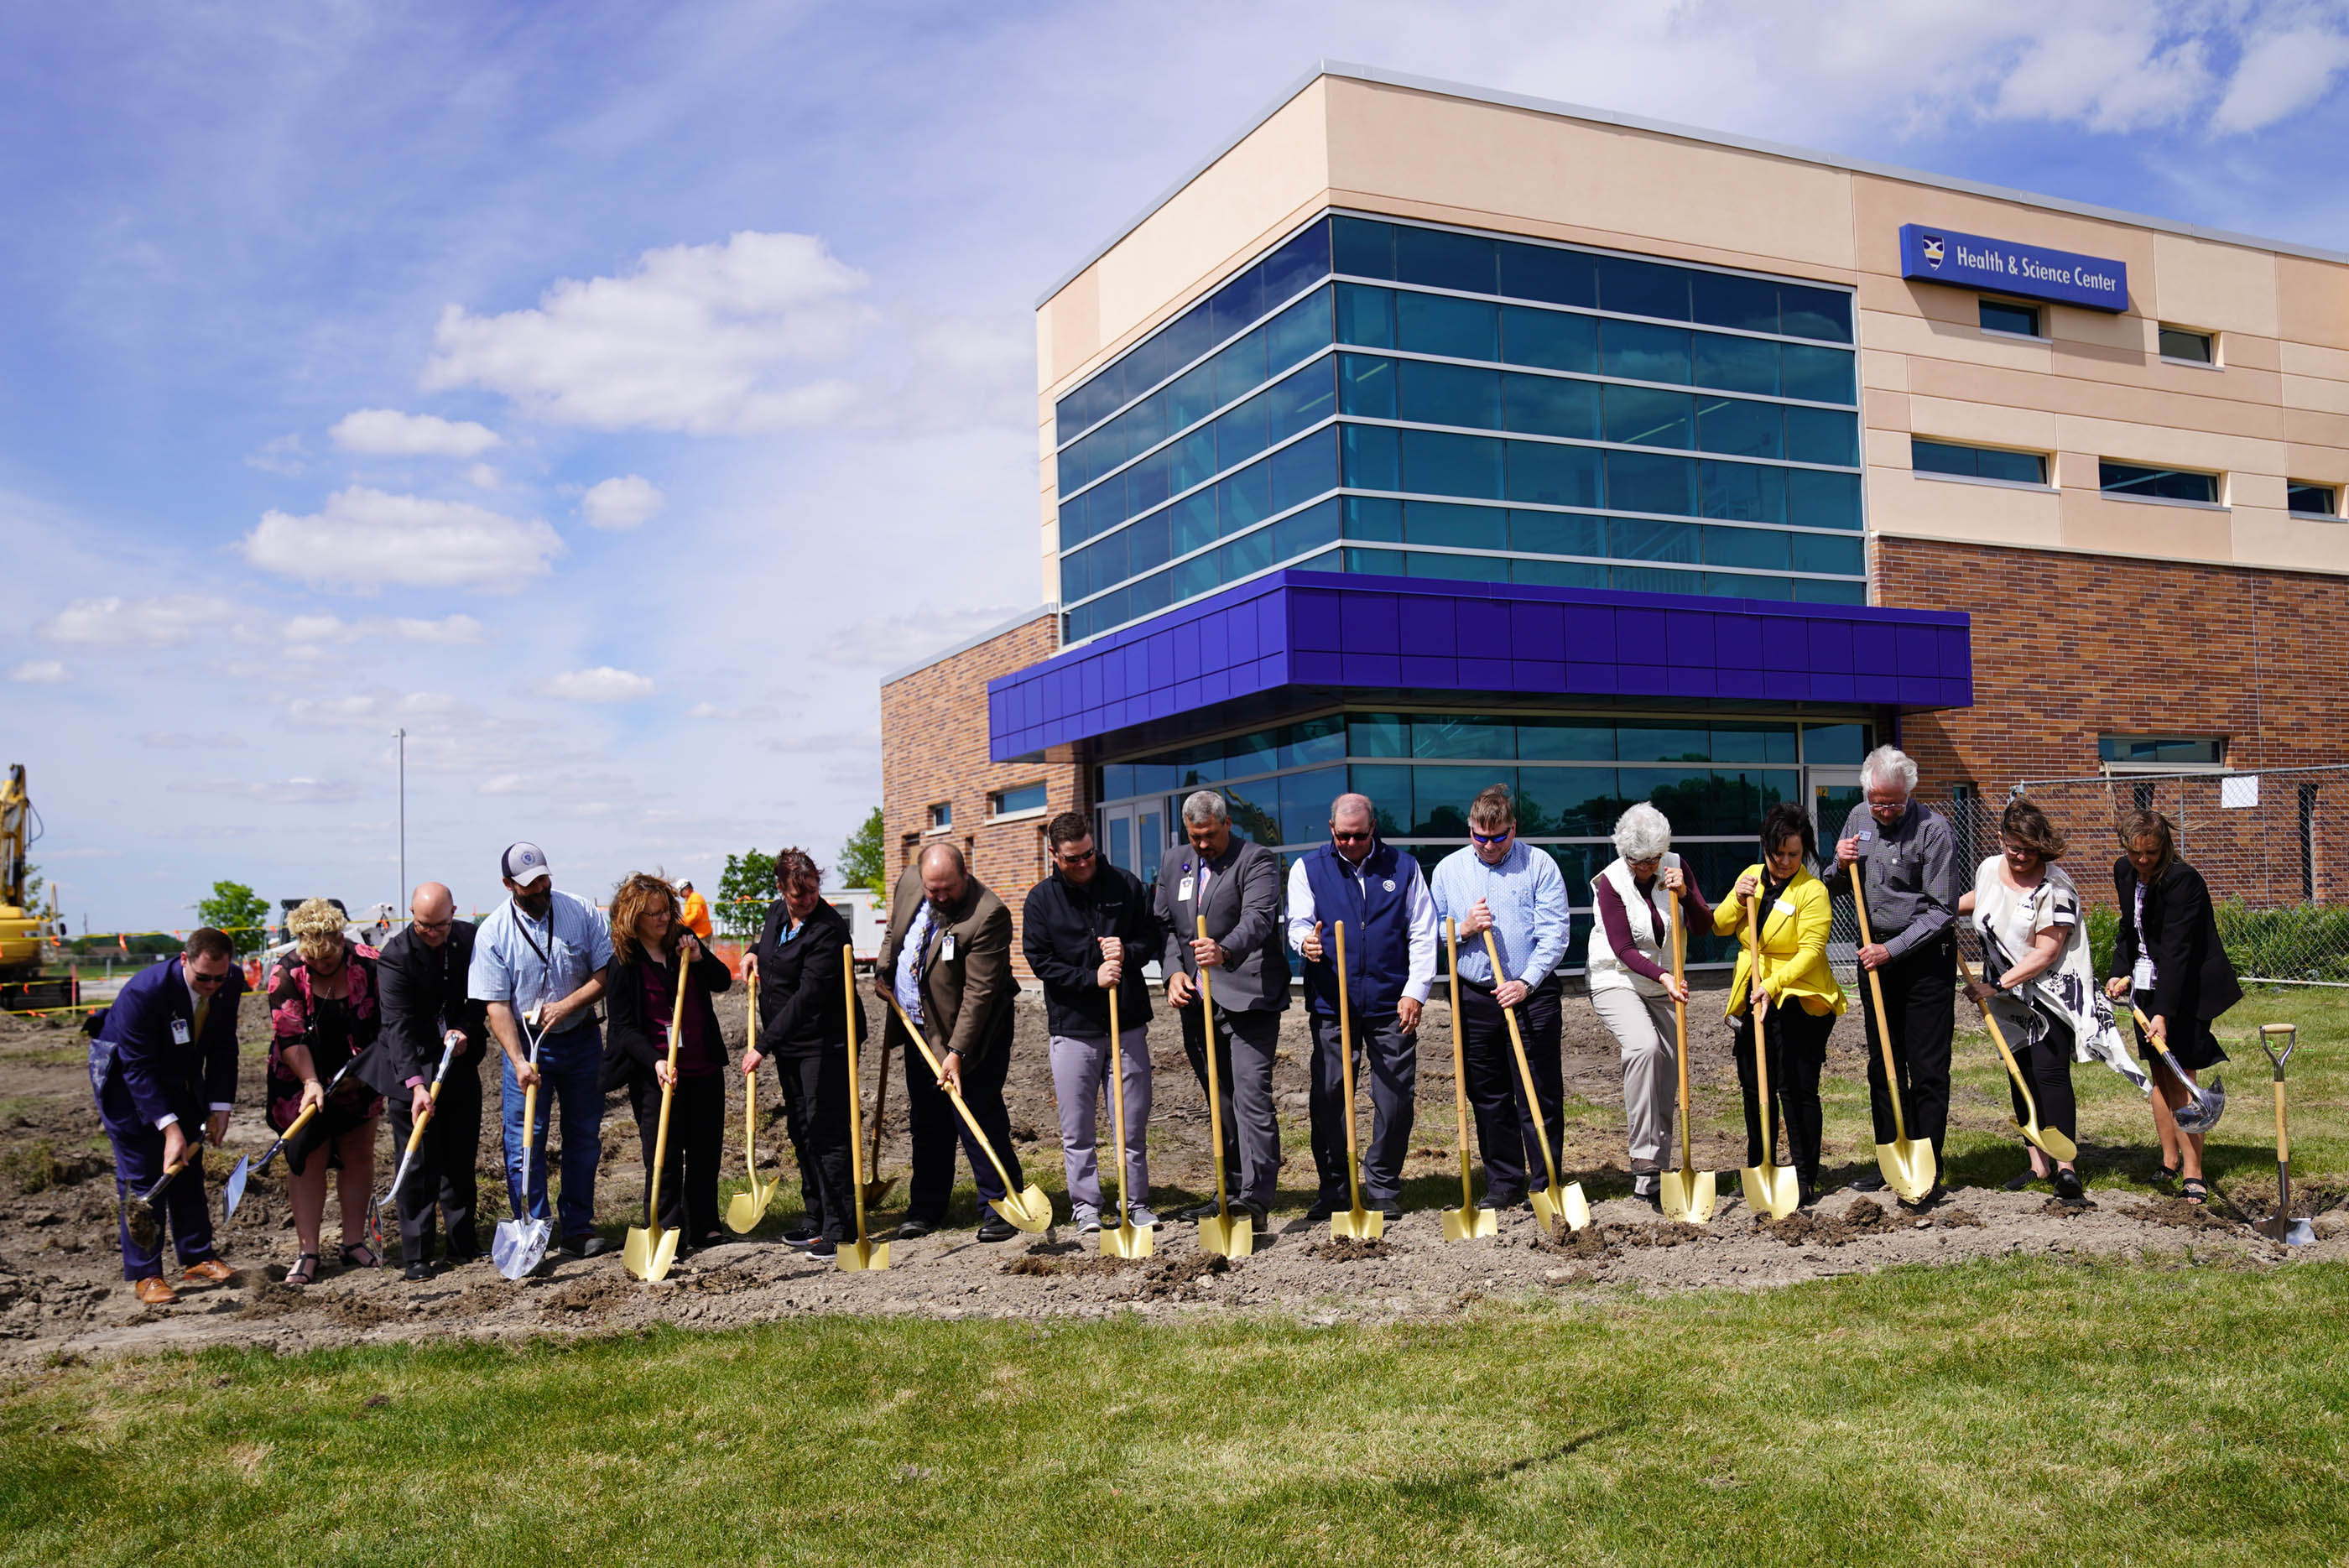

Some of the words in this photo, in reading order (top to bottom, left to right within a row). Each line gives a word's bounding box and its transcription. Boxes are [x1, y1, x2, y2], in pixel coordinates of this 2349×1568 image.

[1957, 245, 2003, 273] Health
[2008, 255, 2018, 275] &
[2022, 257, 2070, 284] Science
[2074, 266, 2116, 291] Center
